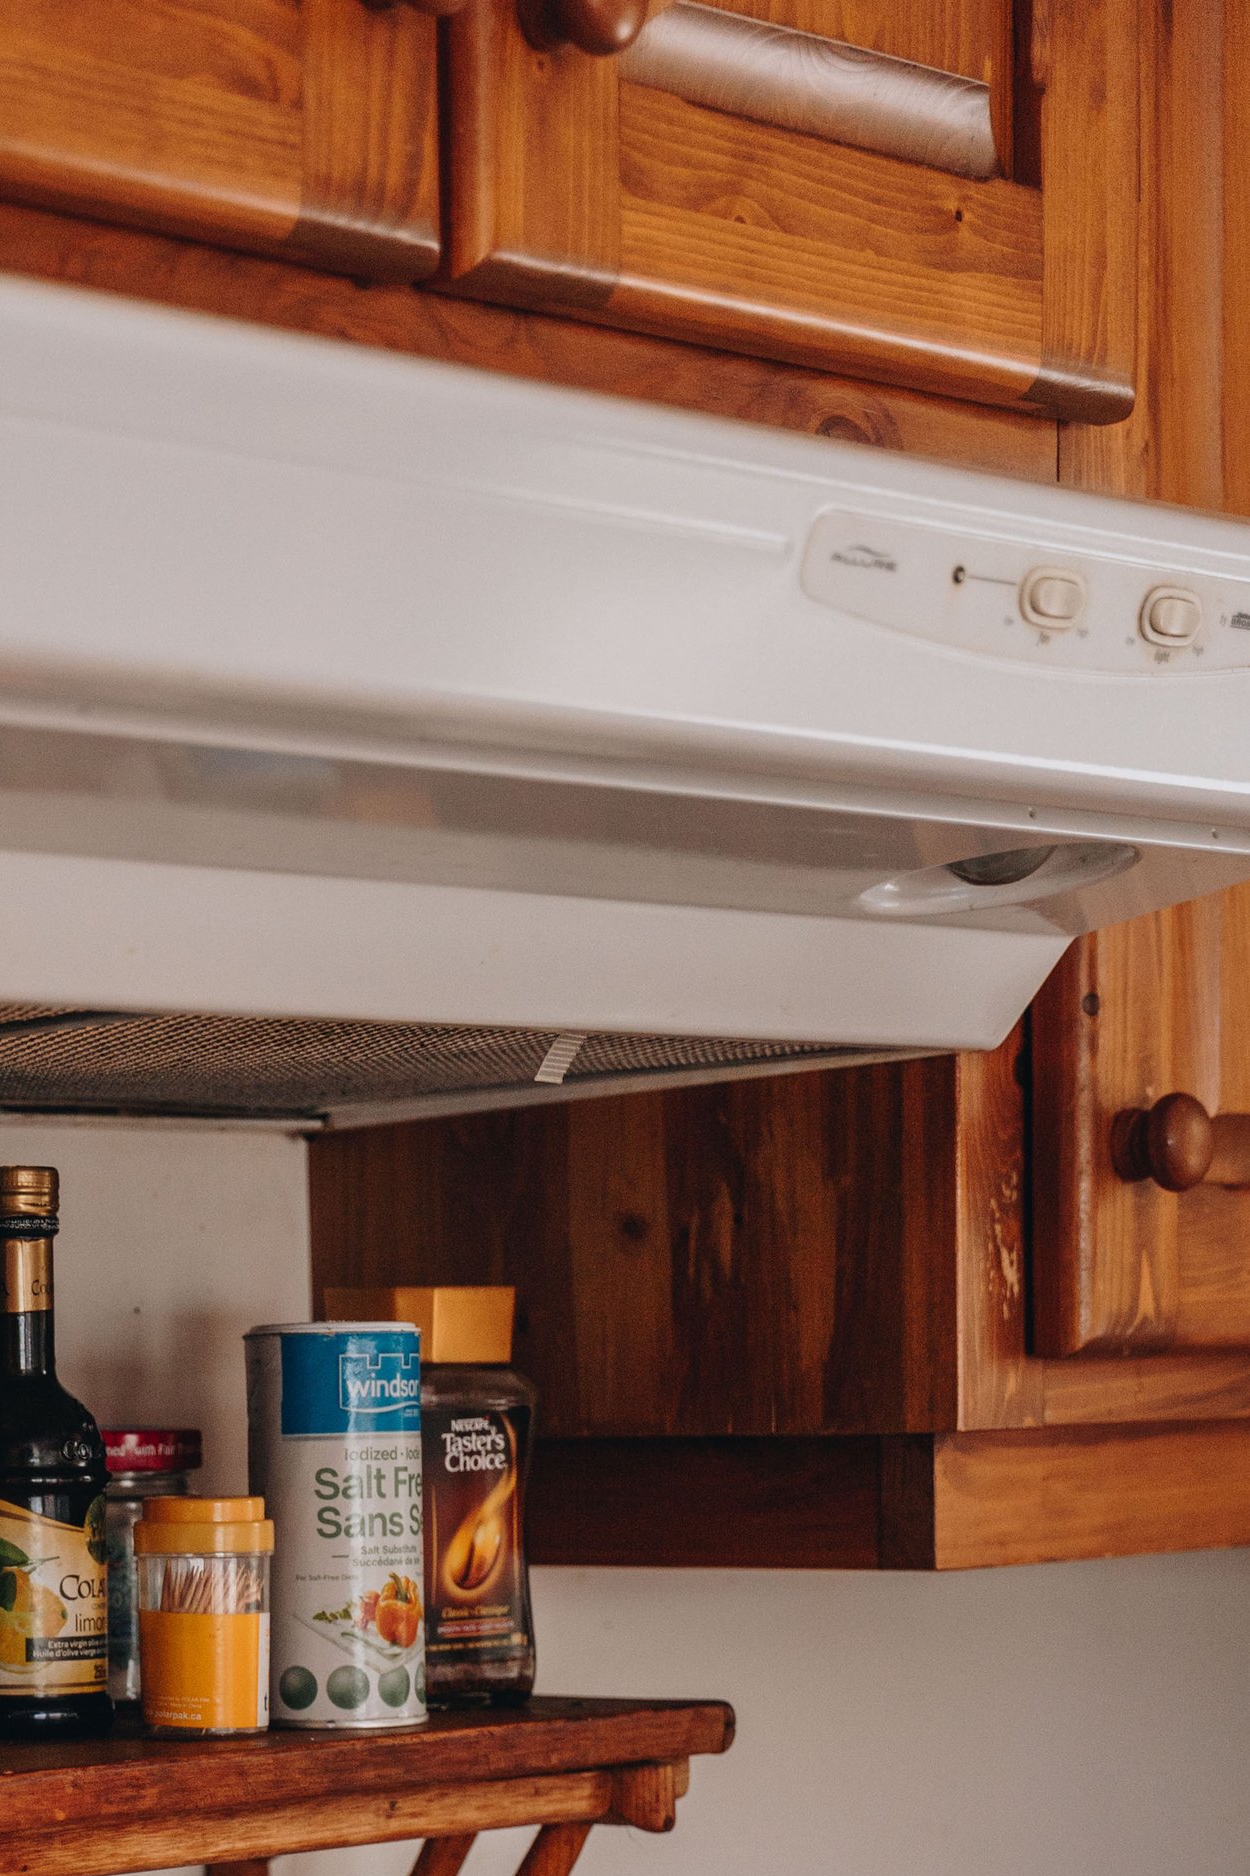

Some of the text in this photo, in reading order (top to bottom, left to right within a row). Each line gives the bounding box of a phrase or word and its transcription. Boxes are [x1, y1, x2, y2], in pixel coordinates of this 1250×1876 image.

[347, 1373, 419, 1398] windsor
[441, 1425, 506, 1453] Taster's
[344, 1446, 397, 1461] Iodized
[445, 1450, 507, 1473] Choice
[314, 1464, 387, 1501] Salt
[316, 1505, 405, 1539] Sans
[361, 1545, 379, 1555] Salt
[32, 1649, 54, 1658] Huile
[55, 1648, 79, 1657] d'olive
[47, 1639, 87, 1649] Extra virgin
